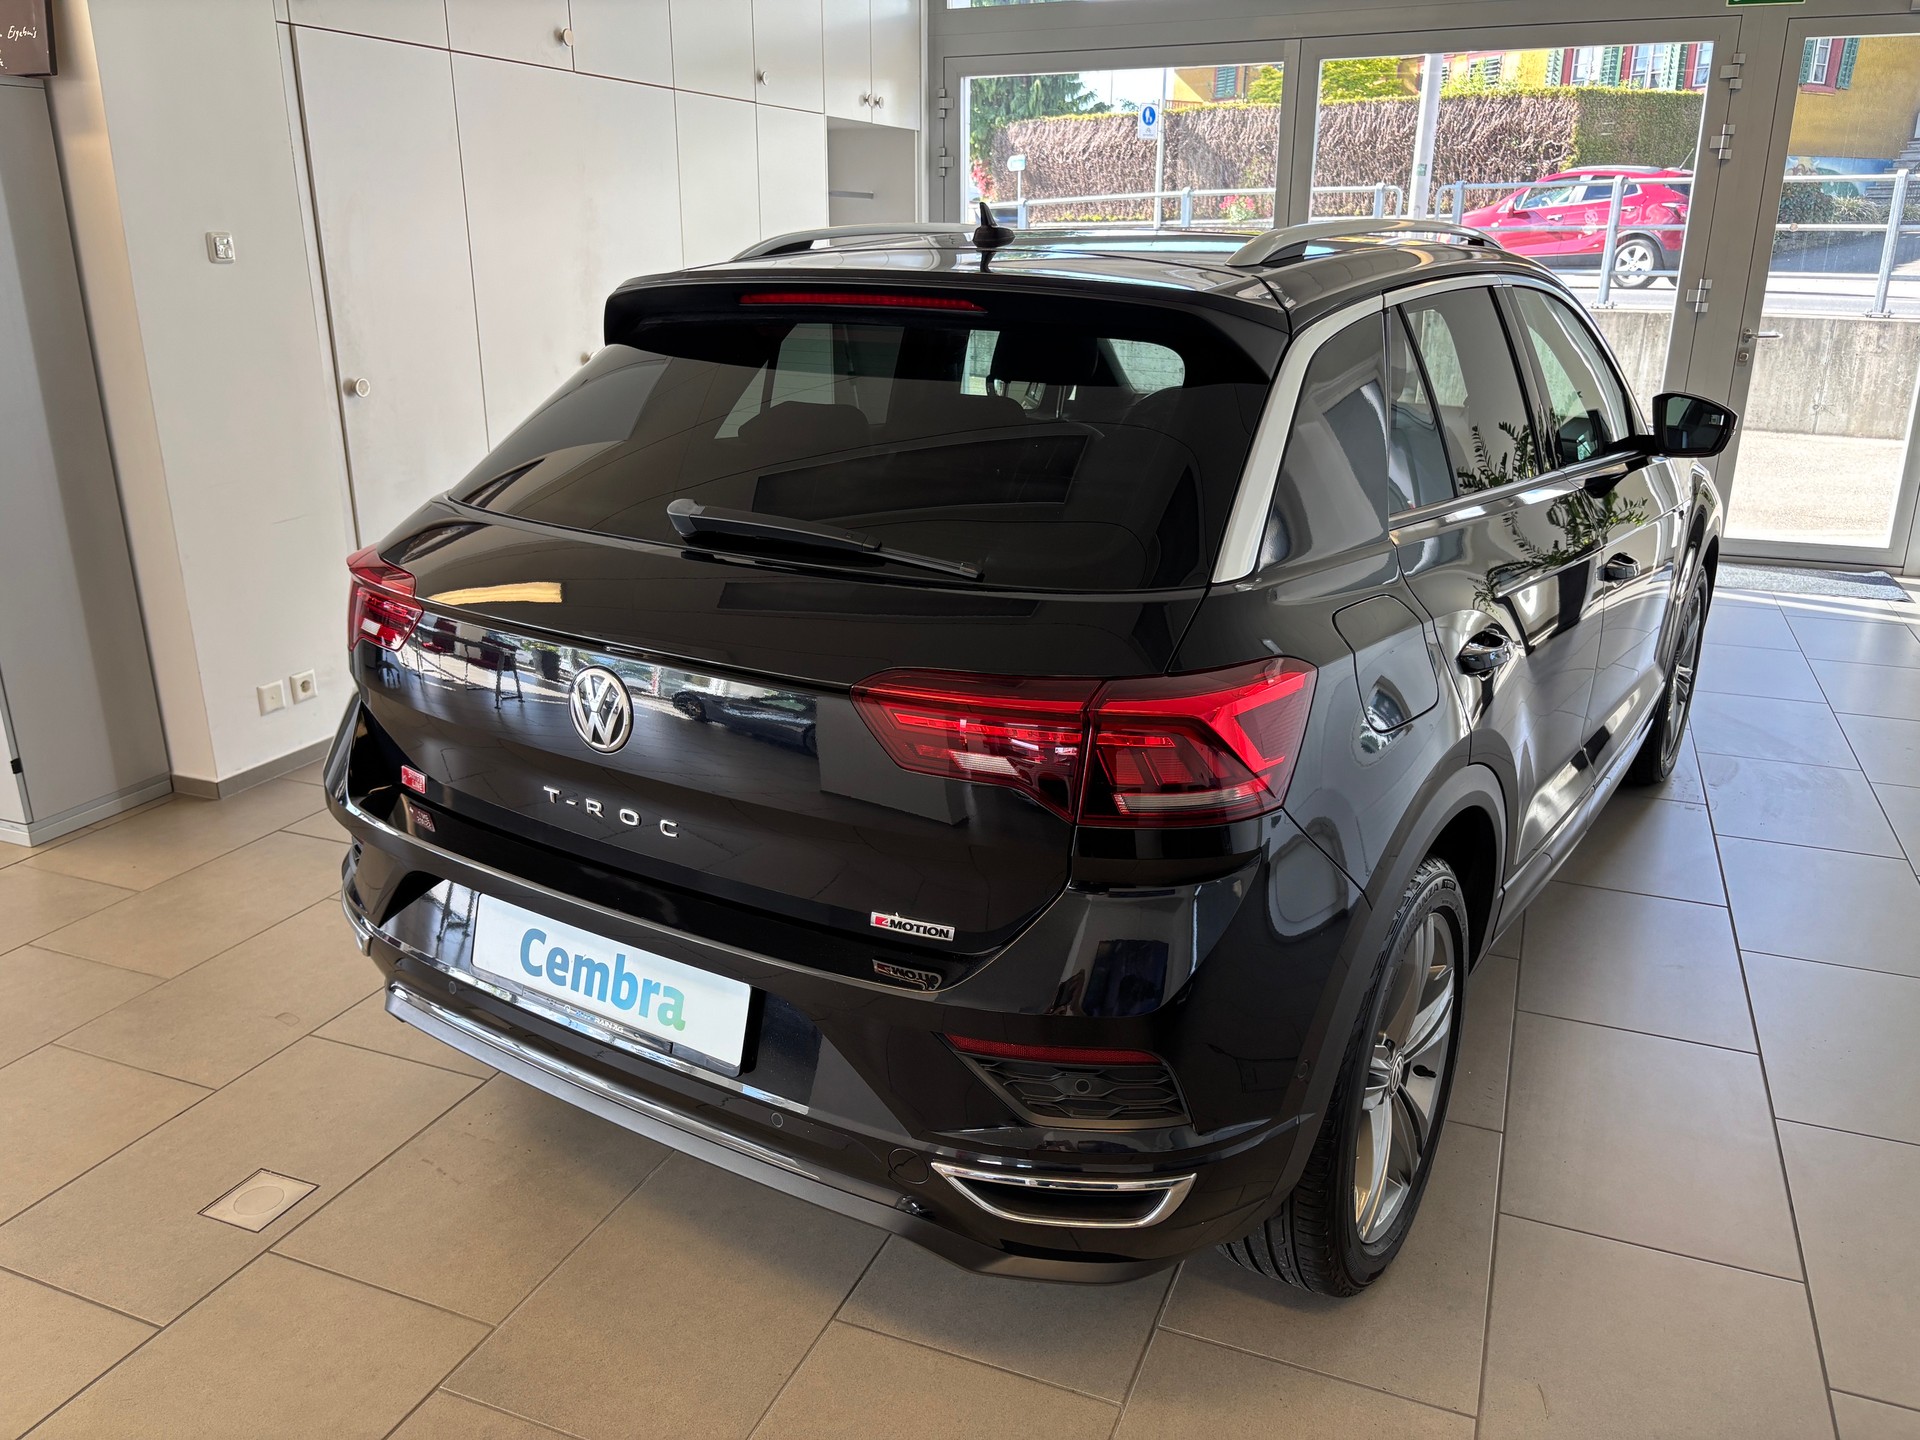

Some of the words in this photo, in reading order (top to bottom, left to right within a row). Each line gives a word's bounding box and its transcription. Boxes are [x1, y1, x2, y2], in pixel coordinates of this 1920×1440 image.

[543, 785, 680, 838] T-ROC
[875, 915, 950, 938] 4MOTION
[519, 927, 686, 1032] Cembra
